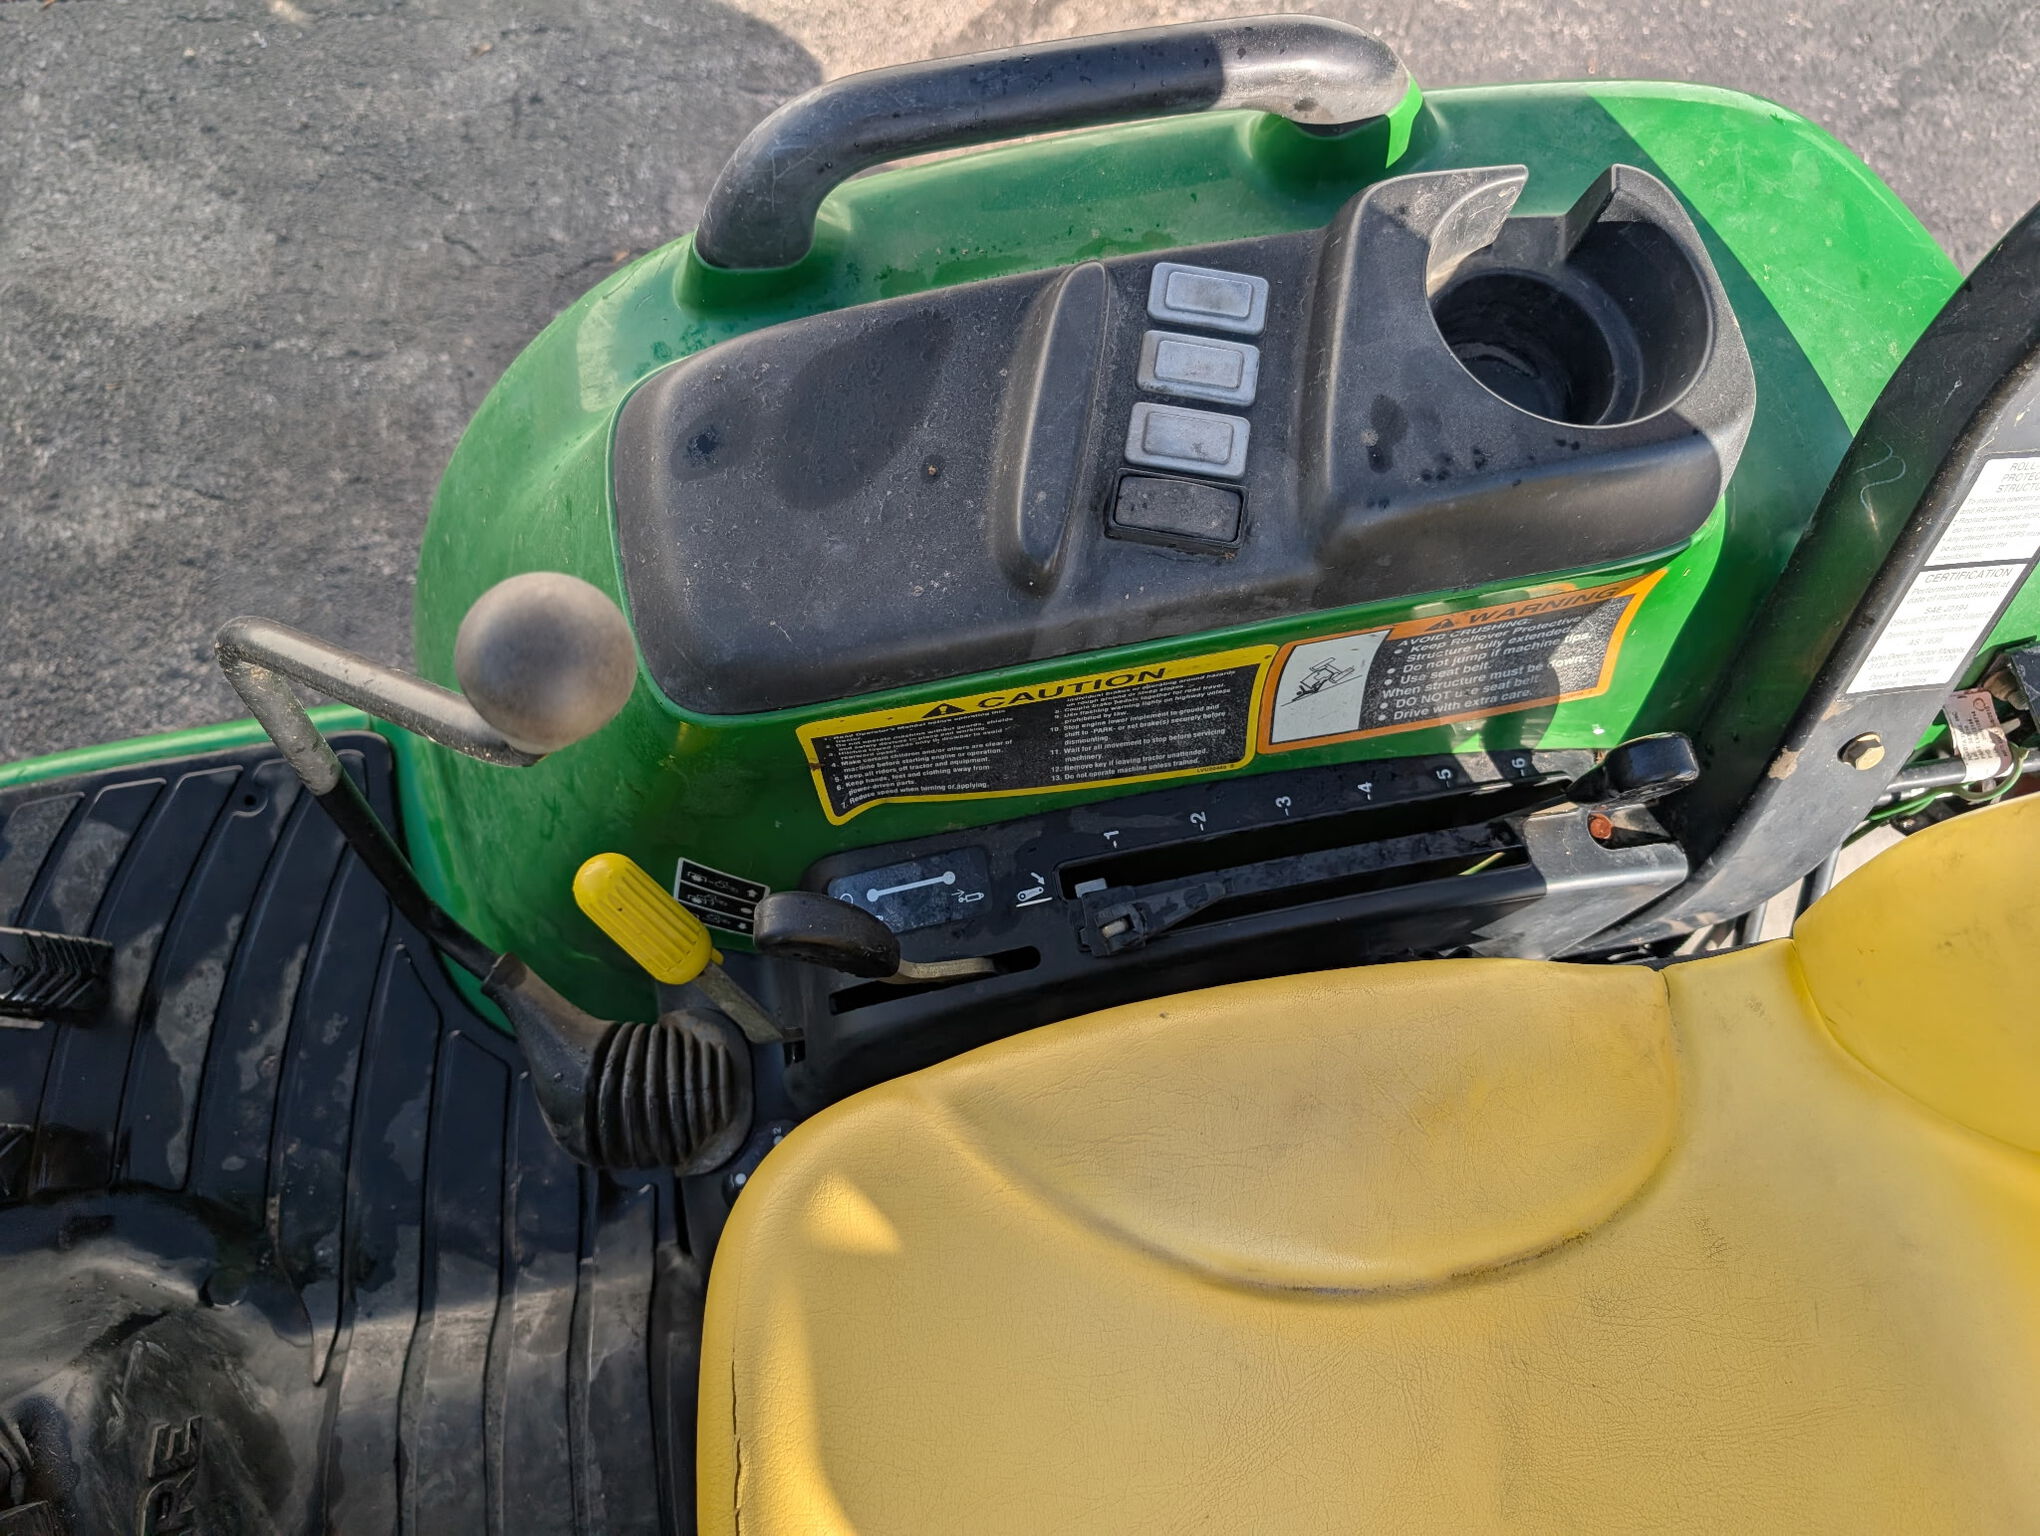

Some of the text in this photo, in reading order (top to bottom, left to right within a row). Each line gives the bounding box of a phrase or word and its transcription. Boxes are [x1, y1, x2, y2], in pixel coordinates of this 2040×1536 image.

[1924, 567, 2013, 584] CERTIFICATION
[1470, 587, 1620, 624] WARNING
[1398, 633, 1449, 647] AVOID
[1410, 641, 1447, 653] Keep
[1512, 615, 1582, 635] Protective
[1403, 631, 1592, 673] Do not jump if machine tips.
[1407, 645, 1472, 663] Structure
[1475, 638, 1504, 651] fully
[1383, 685, 1421, 699] When
[1424, 674, 1486, 692] structure
[1490, 666, 1525, 680] must
[1527, 663, 1544, 673] be
[1400, 661, 1492, 685] Use seat belt.
[977, 667, 1166, 708] CAUTION
[1395, 696, 1417, 709] DO
[1421, 691, 1452, 704] NOT
[1482, 681, 1511, 693] seat
[1081, 721, 1106, 729] engine
[1130, 711, 1169, 721] implement
[1179, 706, 1205, 716] ground
[1206, 703, 1220, 711] and
[1393, 688, 1533, 720] Drive with extra care.
[1064, 730, 1080, 738] shift
[1139, 719, 1170, 728] brake(s)
[1170, 714, 1201, 724] securely
[1202, 711, 1226, 719] before
[985, 740, 1003, 748] clear
[1063, 746, 1080, 754] Wait
[1081, 744, 1092, 752] for
[1104, 739, 1142, 750] movement
[1151, 735, 1167, 743] stop
[1168, 732, 1192, 741] before
[1193, 727, 1226, 738] servicing
[1064, 735, 1111, 746] dismounting.
[1064, 754, 1104, 763] machinery.
[1064, 762, 1094, 772] Remove
[1115, 757, 1141, 766] leaving
[1166, 748, 1208, 759] unattended.
[1088, 769, 1116, 779] operate
[1117, 765, 1148, 774] machine
[1148, 762, 1172, 770] unless
[1172, 758, 1200, 767] trained.
[843, 773, 863, 782] Keep
[845, 780, 864, 788] Keep
[849, 791, 876, 805] Reduce
[876, 788, 899, 796] speed
[920, 783, 946, 791] turning
